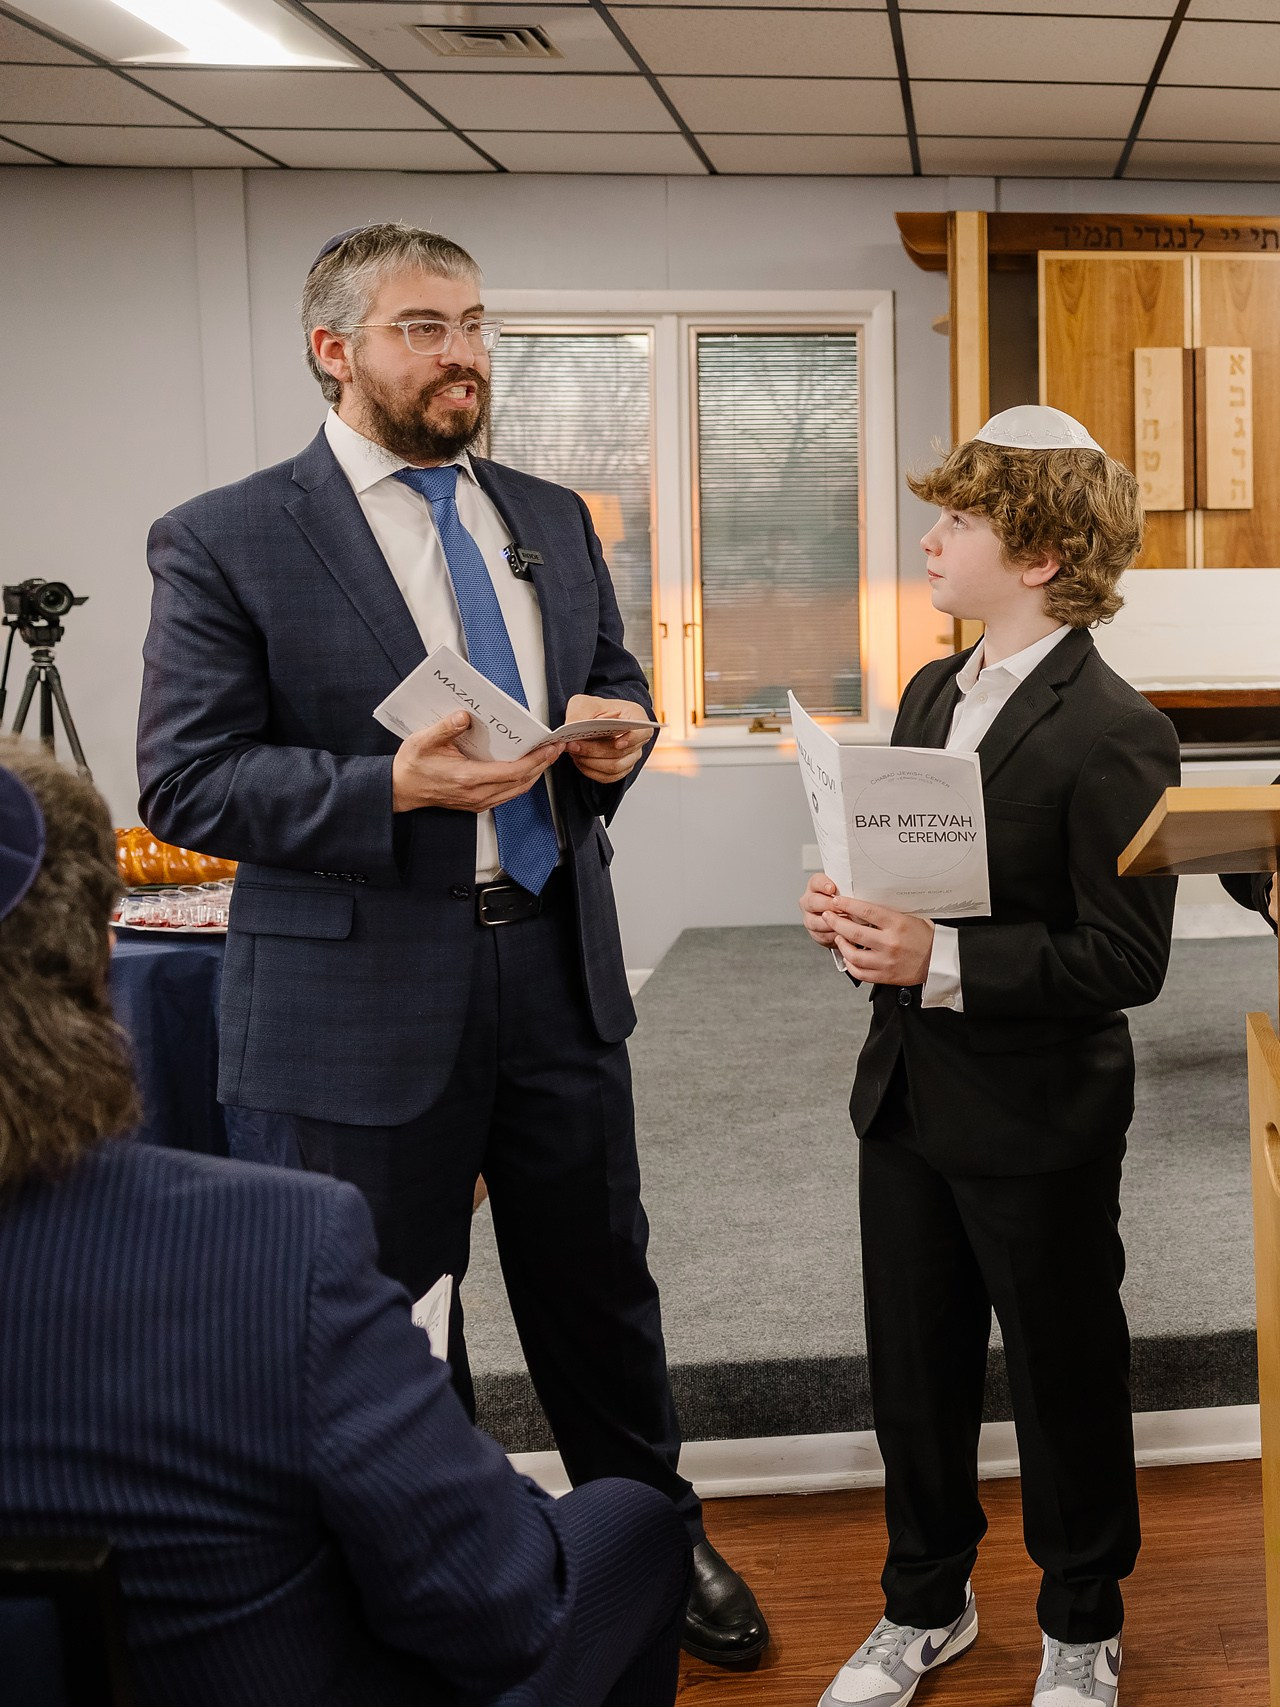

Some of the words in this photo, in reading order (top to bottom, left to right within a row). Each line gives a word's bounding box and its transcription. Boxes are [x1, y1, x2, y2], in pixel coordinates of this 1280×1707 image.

[1054, 225, 1124, 249] תמיד
[1133, 218, 1205, 249] לנגדי
[1229, 354, 1246, 376] א
[1234, 416, 1246, 439] ג
[434, 669, 482, 715] MAZAL
[488, 714, 523, 745] TOV!
[816, 764, 837, 794] TOV!
[855, 814, 892, 828] BAR
[898, 813, 973, 828] MITZVAH
[898, 831, 978, 844] CEREMONY
